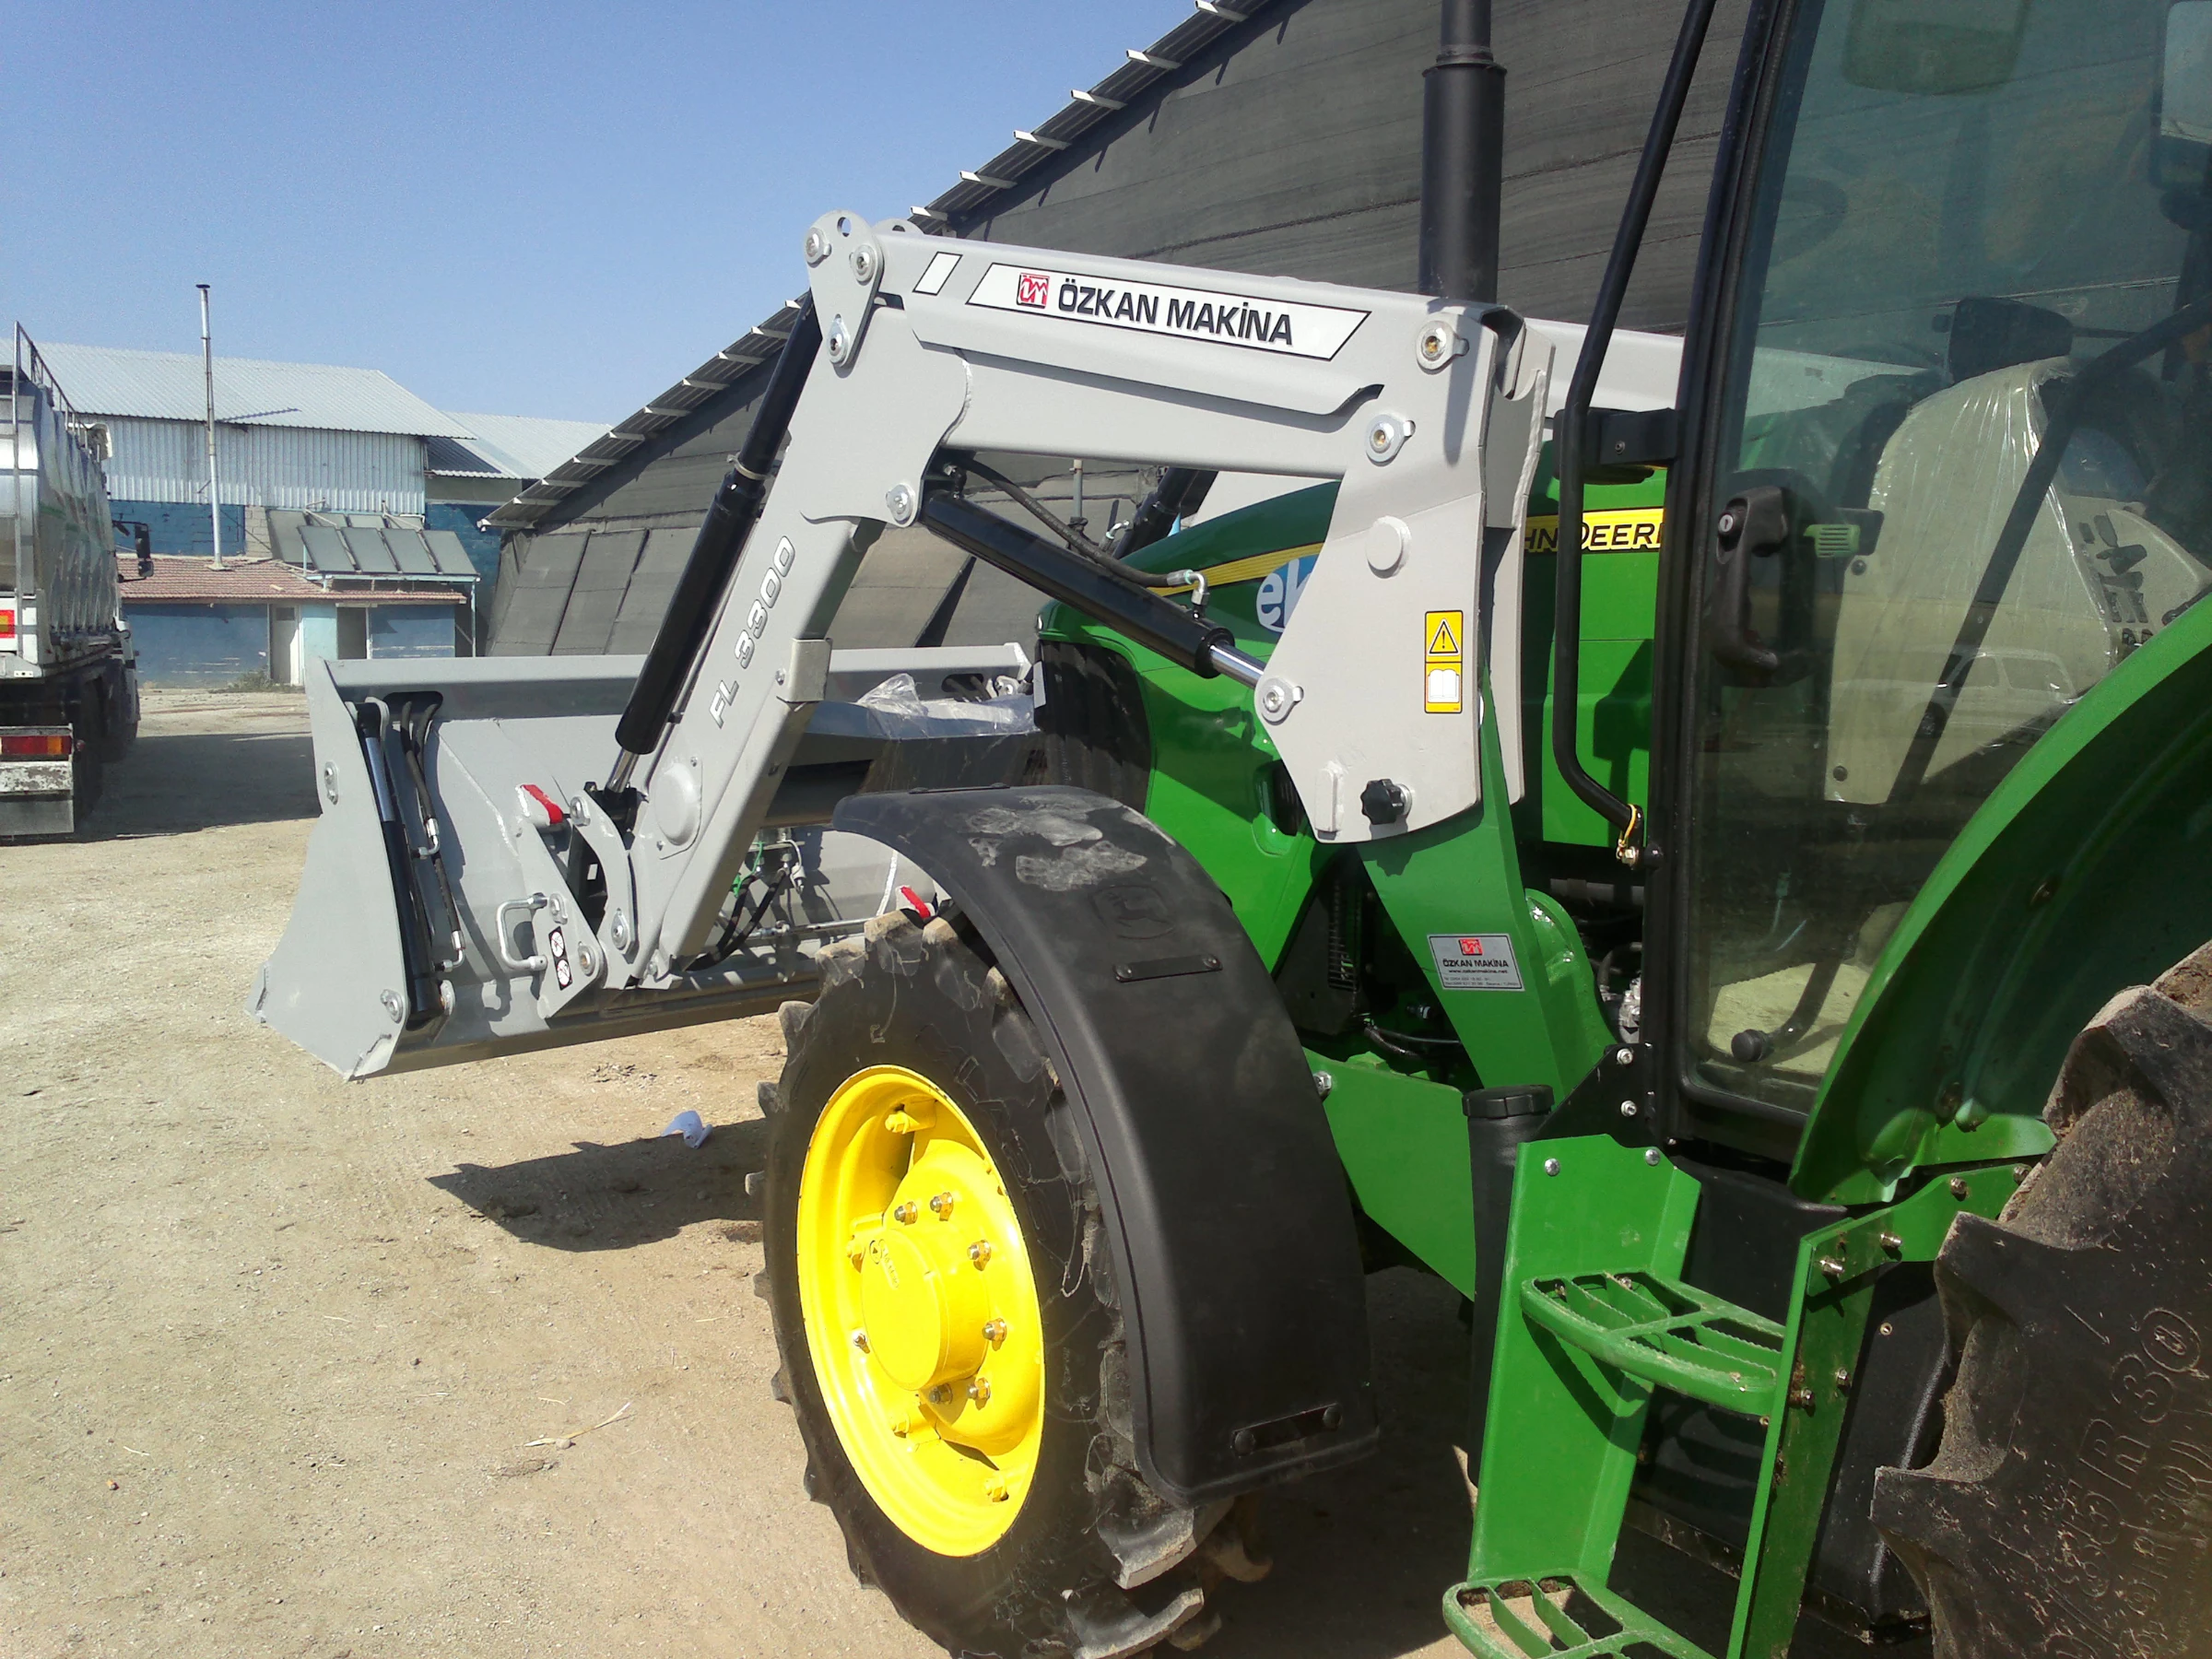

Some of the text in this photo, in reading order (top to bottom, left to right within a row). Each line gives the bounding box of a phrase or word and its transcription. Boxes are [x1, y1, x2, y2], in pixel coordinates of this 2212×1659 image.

[1058, 277, 1292, 346] ÖZKAN MAKİNA
[1581, 522, 1663, 547] DEER
[709, 535, 796, 729] FL 3300
